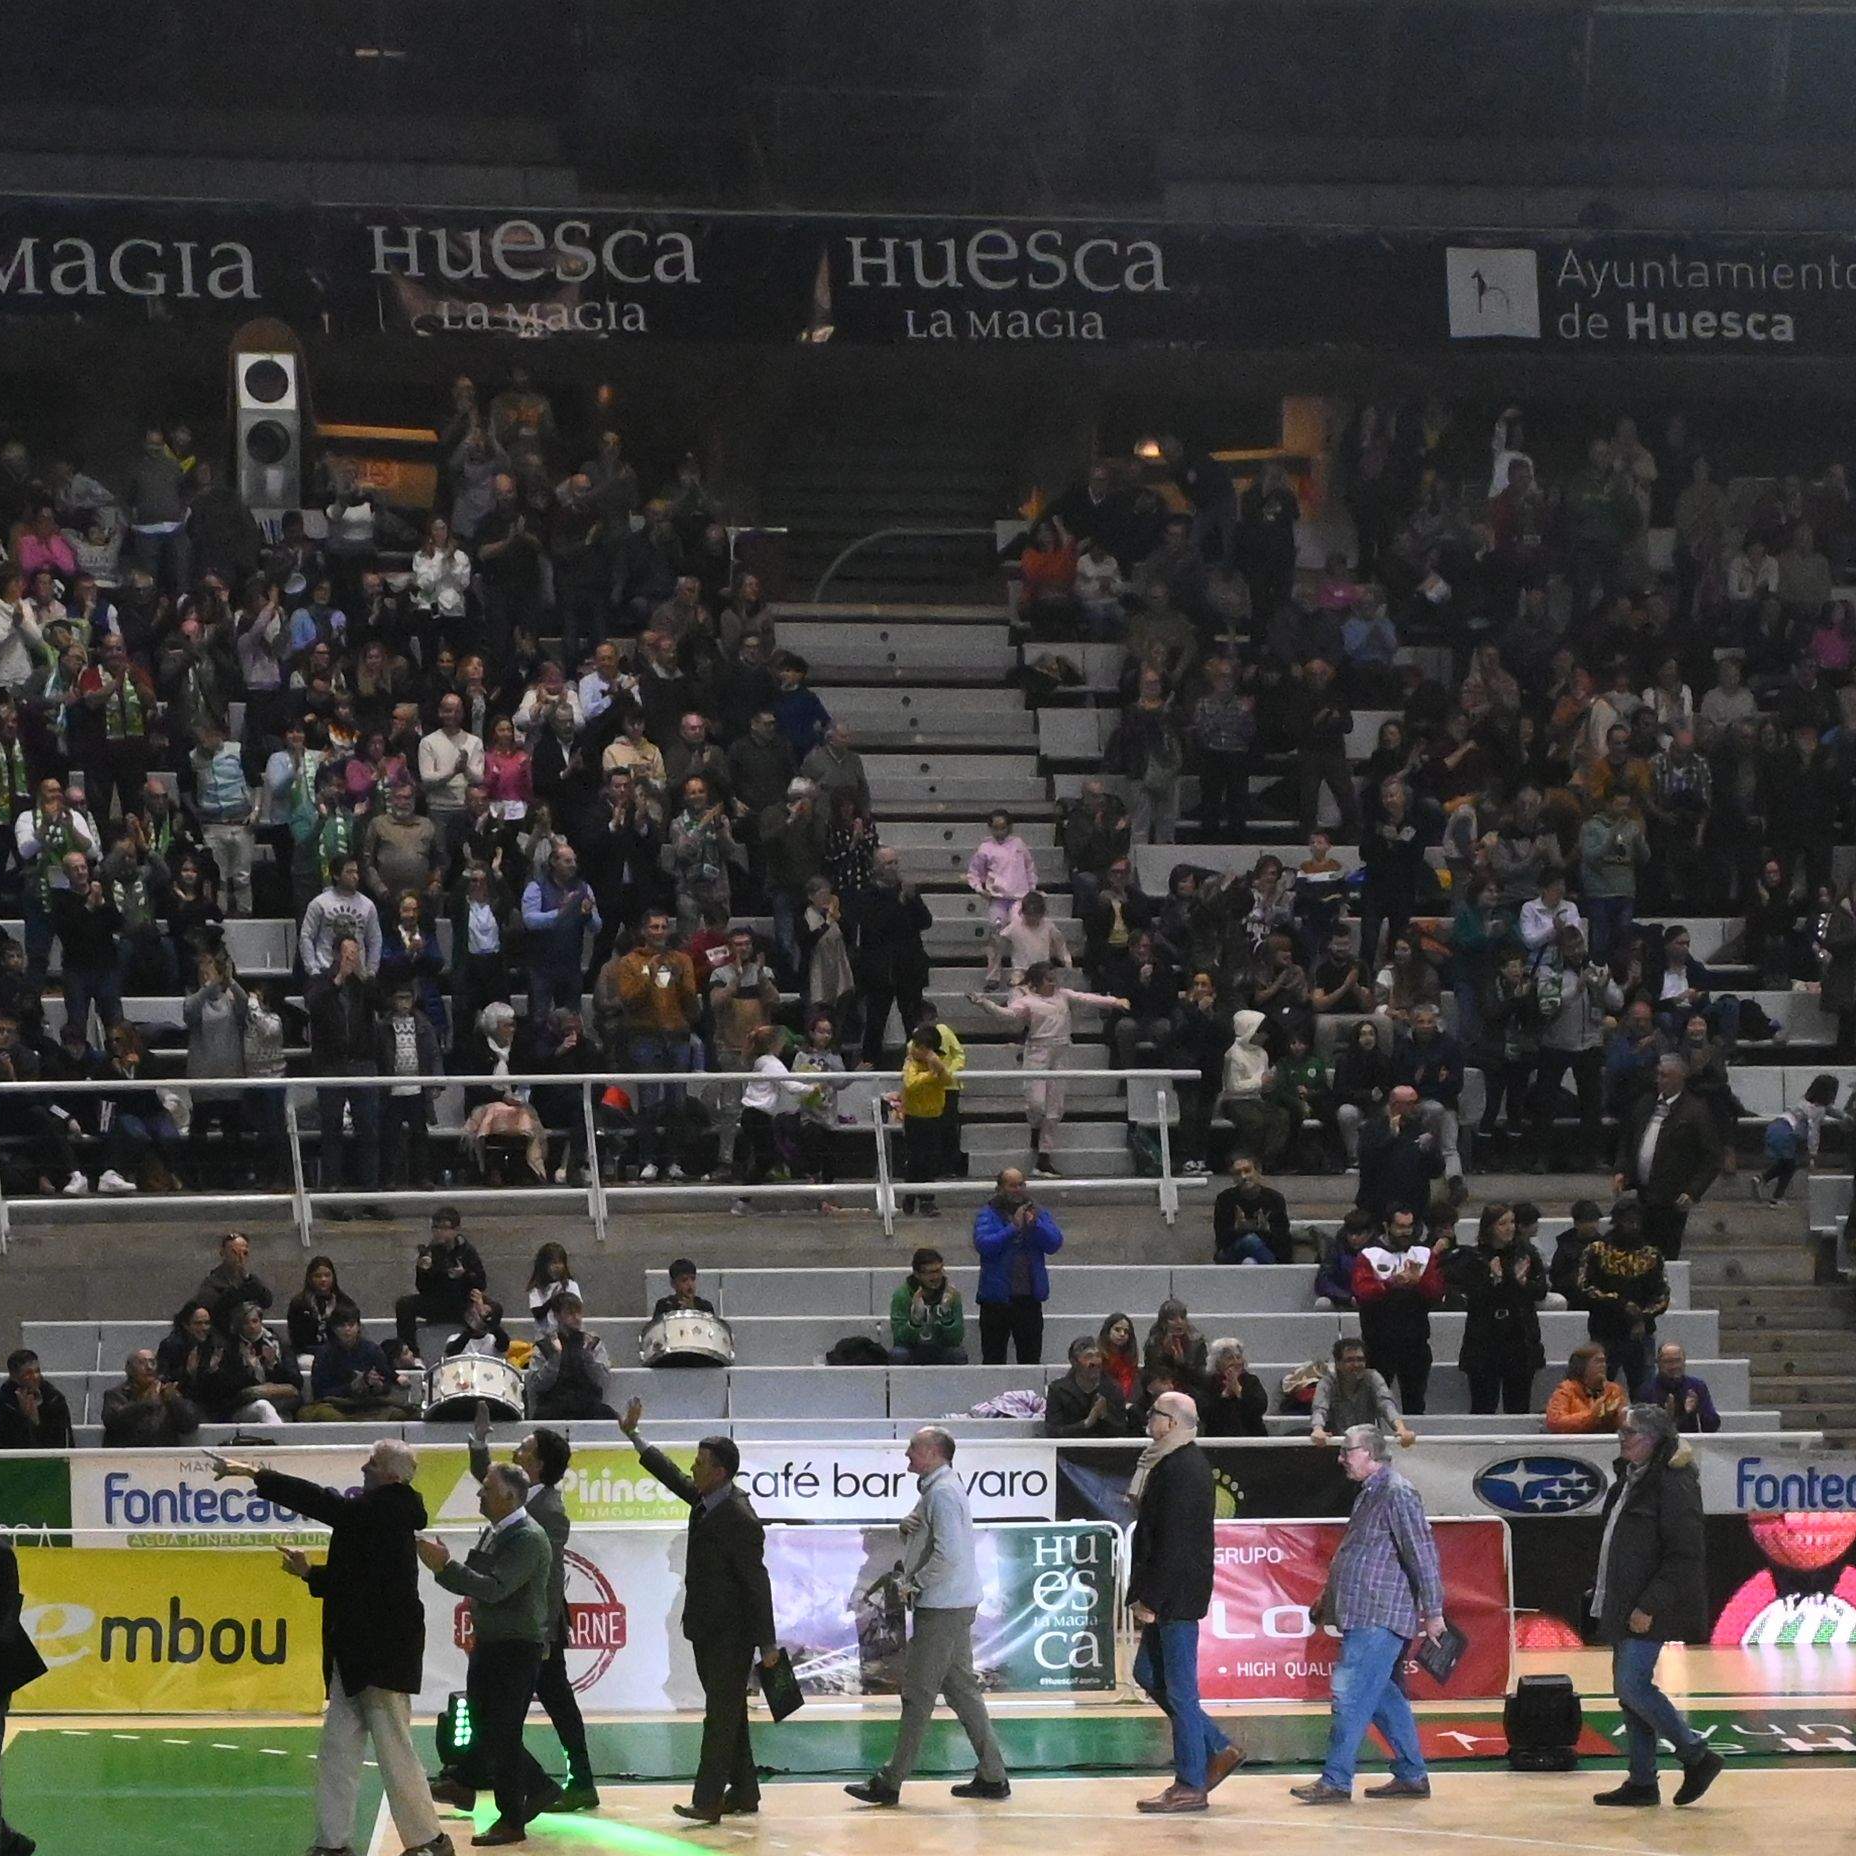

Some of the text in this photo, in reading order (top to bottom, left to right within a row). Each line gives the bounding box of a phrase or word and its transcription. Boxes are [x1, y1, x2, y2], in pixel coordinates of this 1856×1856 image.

[1558, 302, 1796, 343] de Huesca
[737, 1461, 820, 1499] café
[834, 1462, 906, 1499] bar
[187, 1531, 264, 1547] MINERAL
[1213, 1547, 1282, 1564] GRUPO
[1237, 1662, 1276, 1677] HIGH
